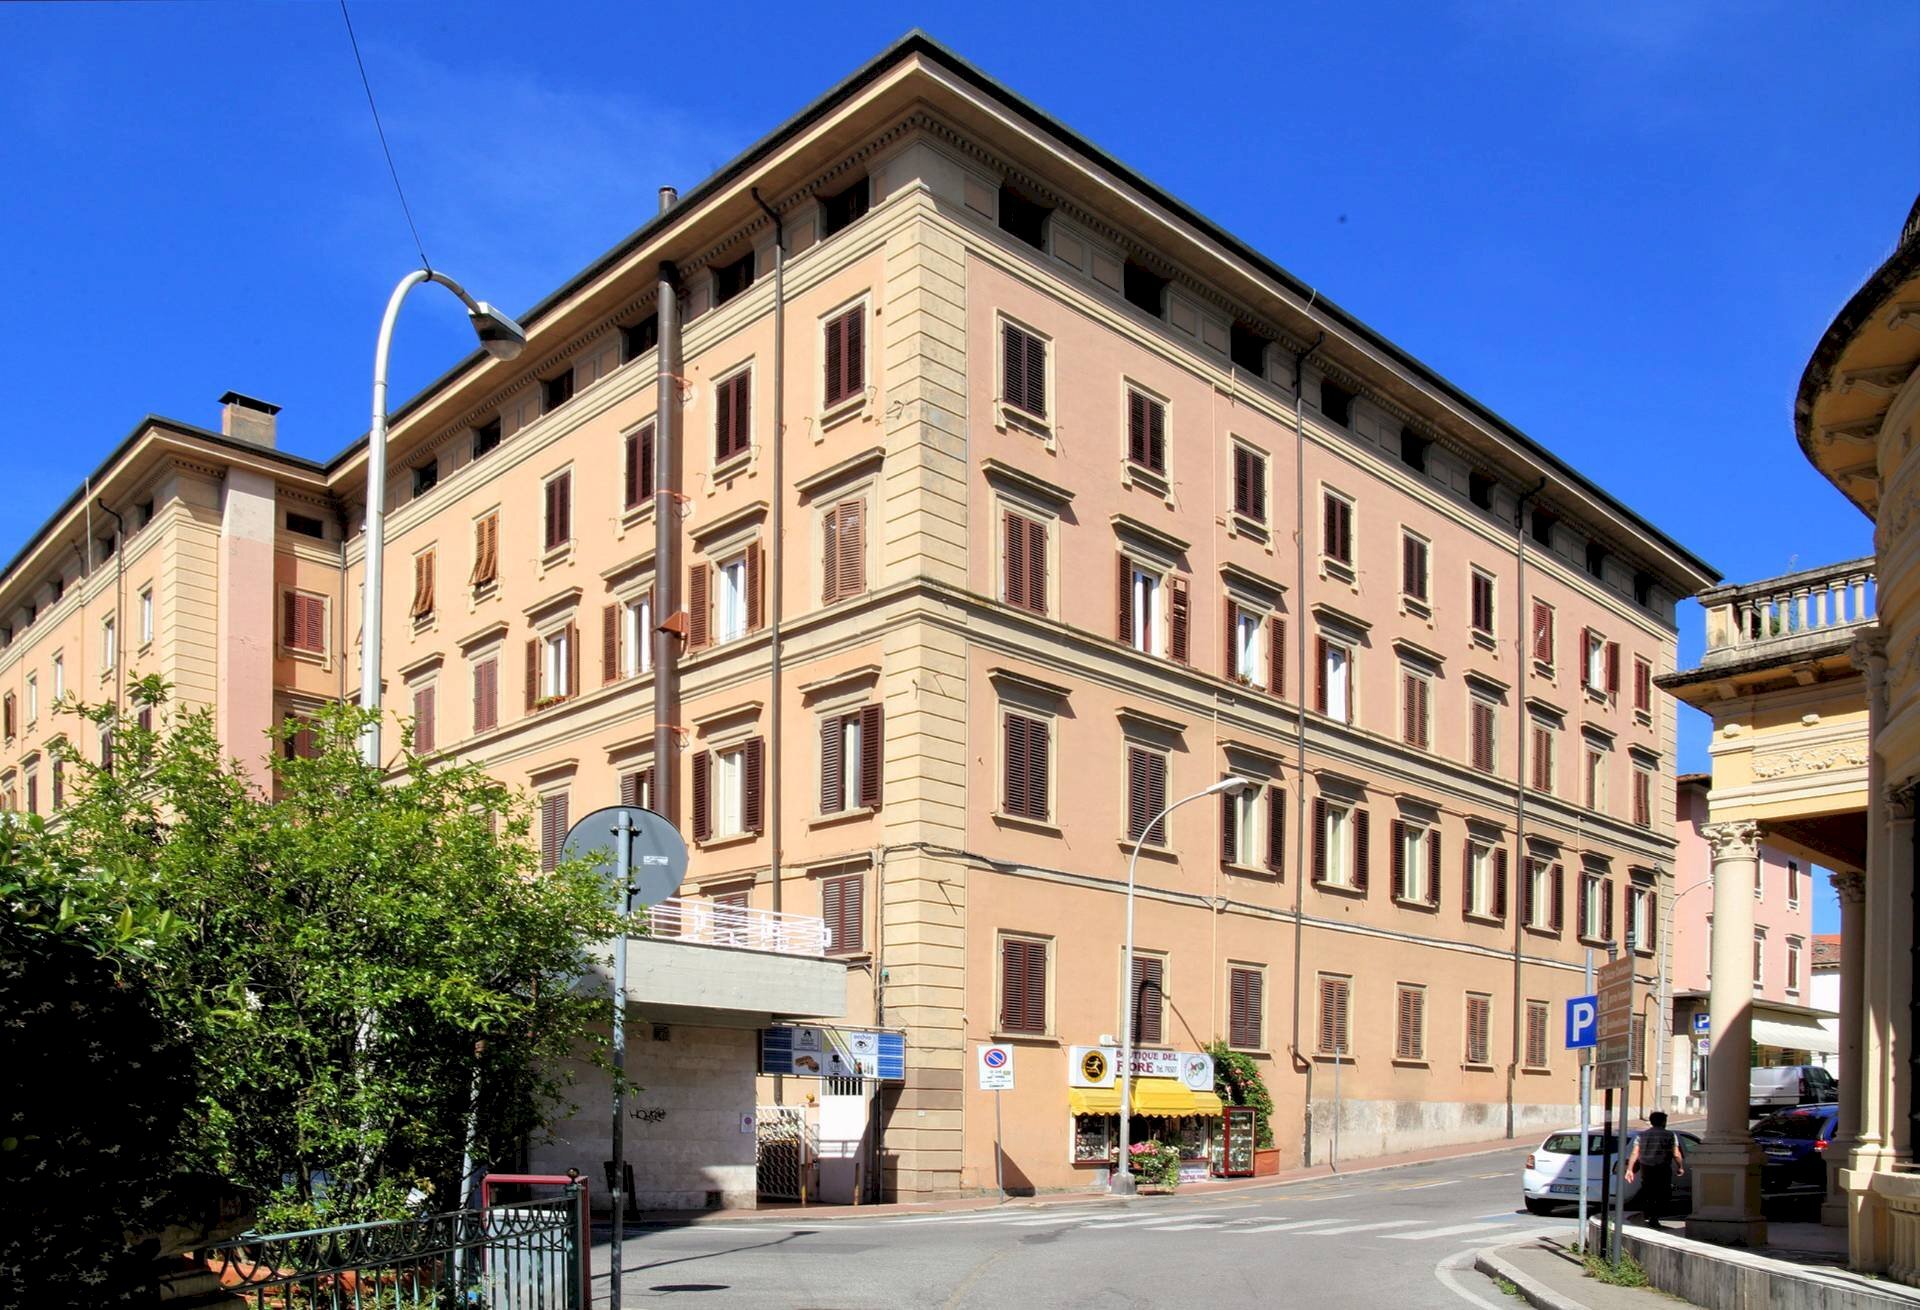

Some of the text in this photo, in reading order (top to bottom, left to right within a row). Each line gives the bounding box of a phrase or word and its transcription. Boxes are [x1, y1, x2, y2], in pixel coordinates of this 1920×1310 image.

[1572, 1002, 1595, 1042] P
[1698, 1014, 1710, 1027] P
[1116, 1050, 1178, 1061] BTIQUE DEL
[1116, 1060, 1154, 1073] FORE
